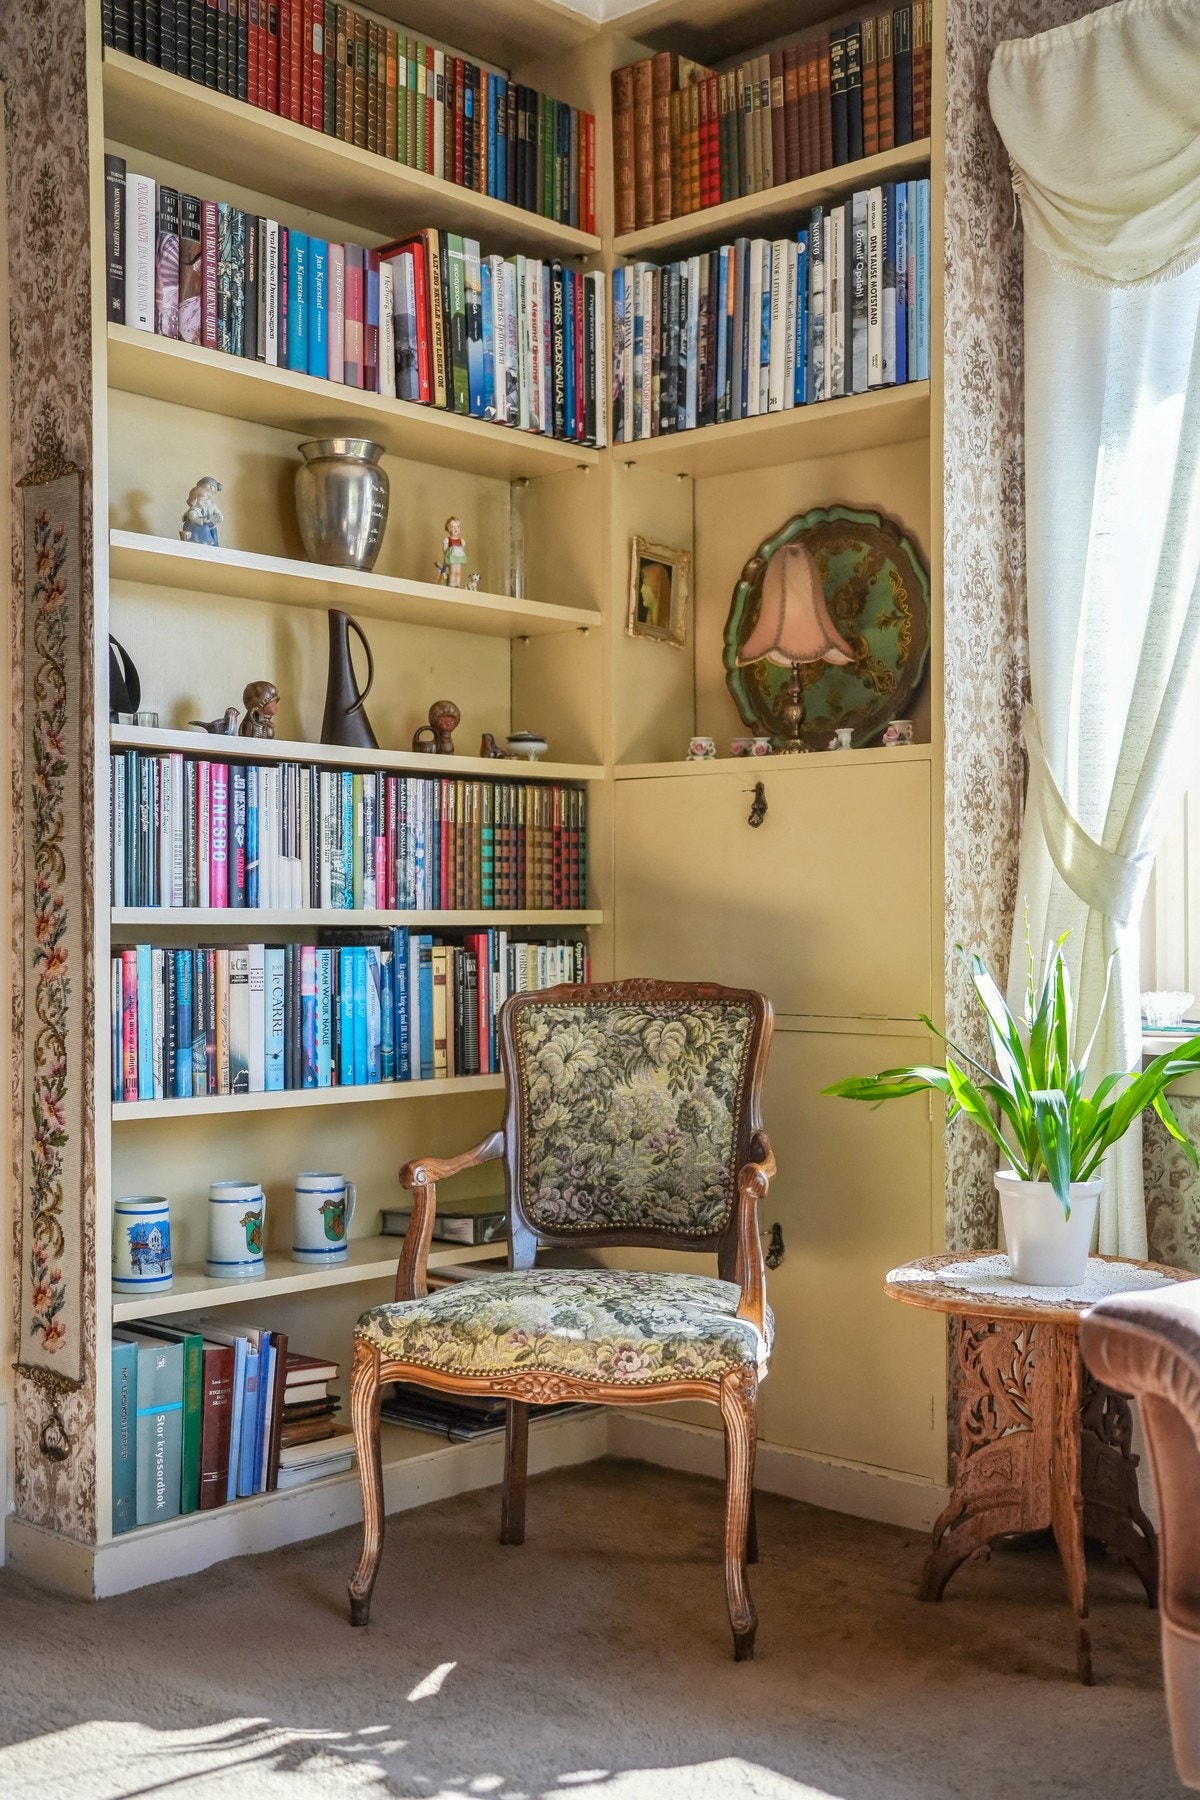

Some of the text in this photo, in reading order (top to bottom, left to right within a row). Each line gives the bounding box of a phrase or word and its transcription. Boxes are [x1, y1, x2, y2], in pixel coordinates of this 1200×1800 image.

[164, 196, 176, 205] TATT
[186, 203, 197, 211] TATT
[160, 214, 178, 224] VINDEN
[182, 221, 200, 230] VINDEN
[296, 248, 304, 263] Jan
[205, 204, 216, 341] MARILYN FRENCH DET HJERTE
[335, 261, 343, 276] Jan
[315, 254, 324, 309] Jan Kjærstad
[855, 262, 863, 297] Opdahl
[384, 275, 392, 310] Herbjørg
[786, 321, 792, 331] og
[553, 282, 564, 404] DREYERS VERDENSATLAS
[437, 375, 444, 388] OM
[234, 775, 245, 789] JO
[212, 780, 226, 862] JO NESBØ
[272, 973, 283, 985] le
[519, 954, 528, 991] GRISHAM
[398, 996, 406, 1006] krig
[155, 1415, 166, 1508] Stor kryssordbok
